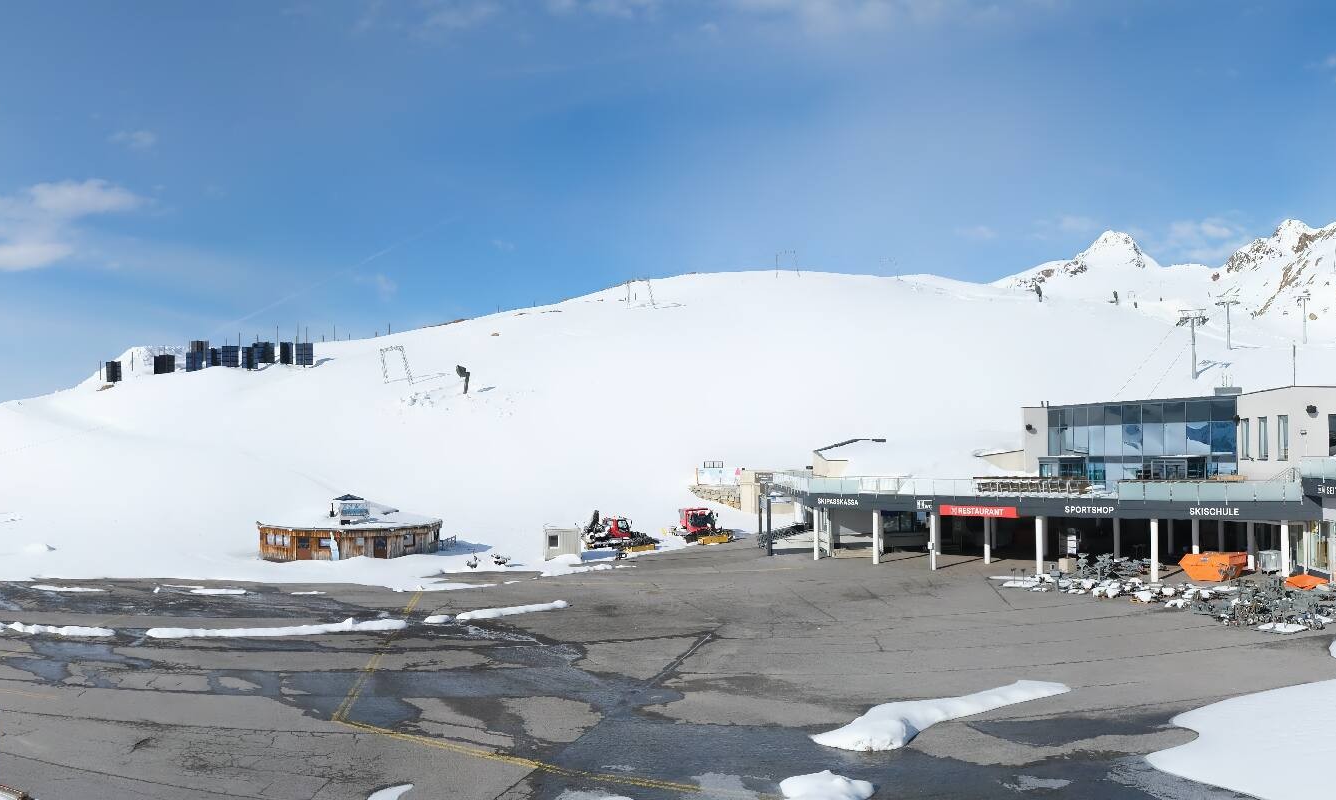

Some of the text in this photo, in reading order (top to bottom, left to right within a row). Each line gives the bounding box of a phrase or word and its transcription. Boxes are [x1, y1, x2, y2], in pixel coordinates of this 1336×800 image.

[817, 497, 859, 506] SKIPASSKASSA
[958, 507, 1004, 516] RESTAURANT
[1064, 505, 1114, 514] SPORTSHOP
[1189, 507, 1240, 516] SKISCHULE
